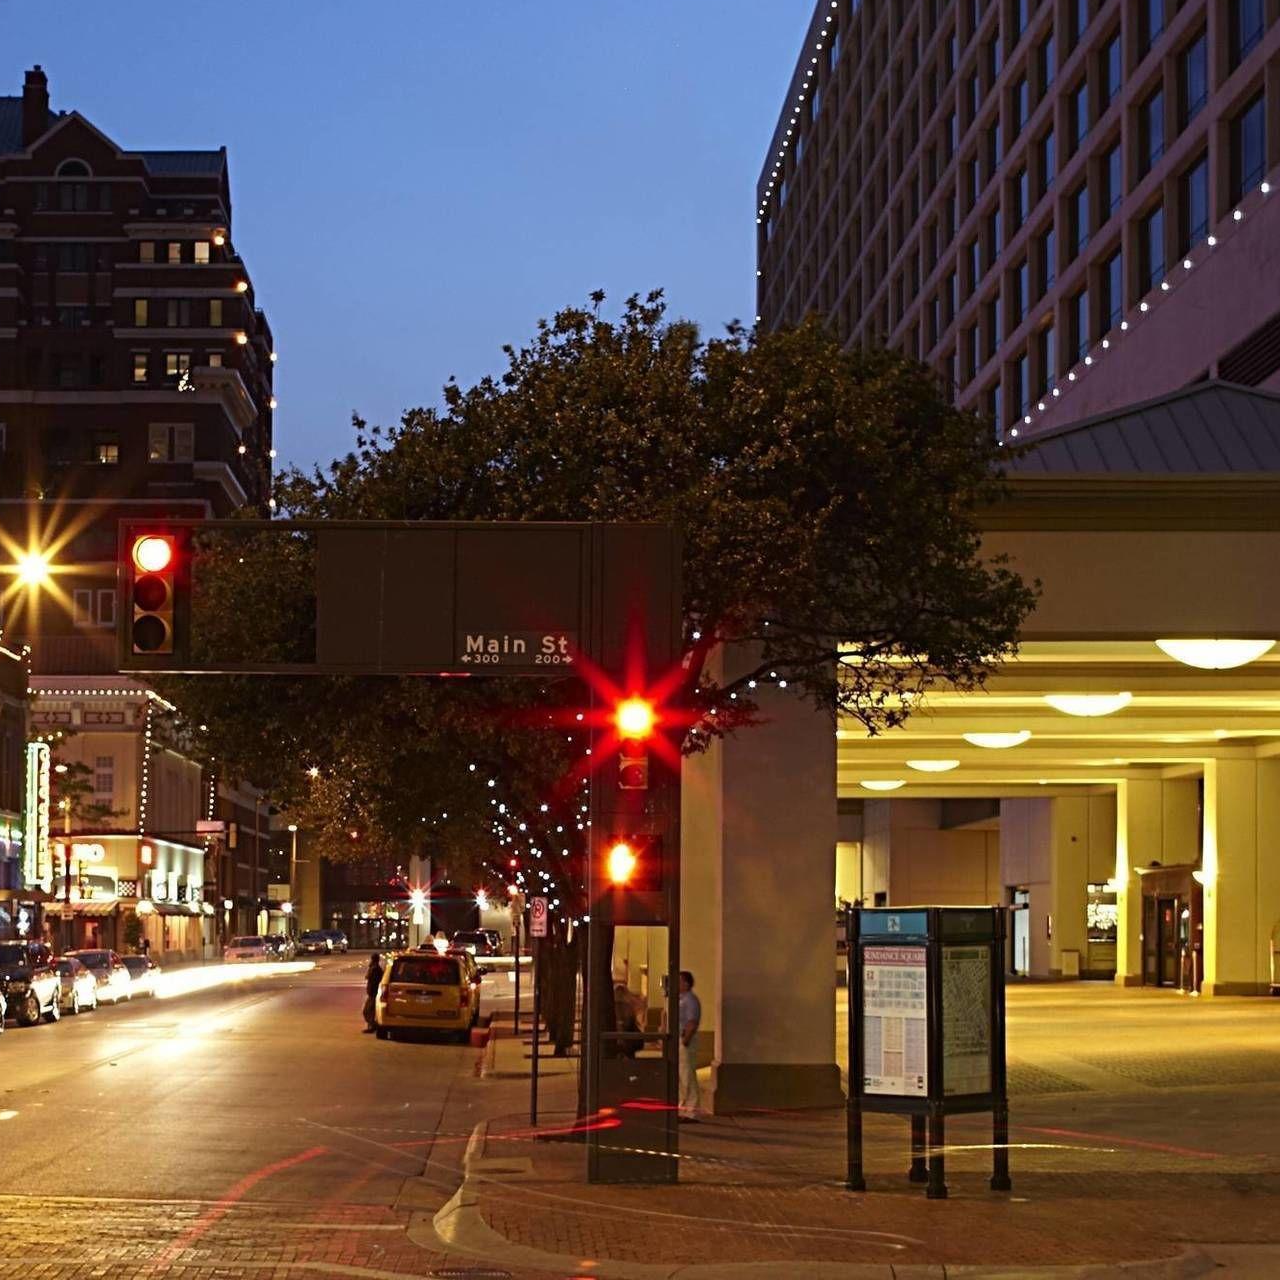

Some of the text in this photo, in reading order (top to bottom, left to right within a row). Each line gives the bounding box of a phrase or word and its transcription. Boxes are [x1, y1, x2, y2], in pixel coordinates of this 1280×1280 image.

[466, 635, 568, 654] Main St
[474, 654, 500, 664] 300
[535, 654, 561, 664] 200
